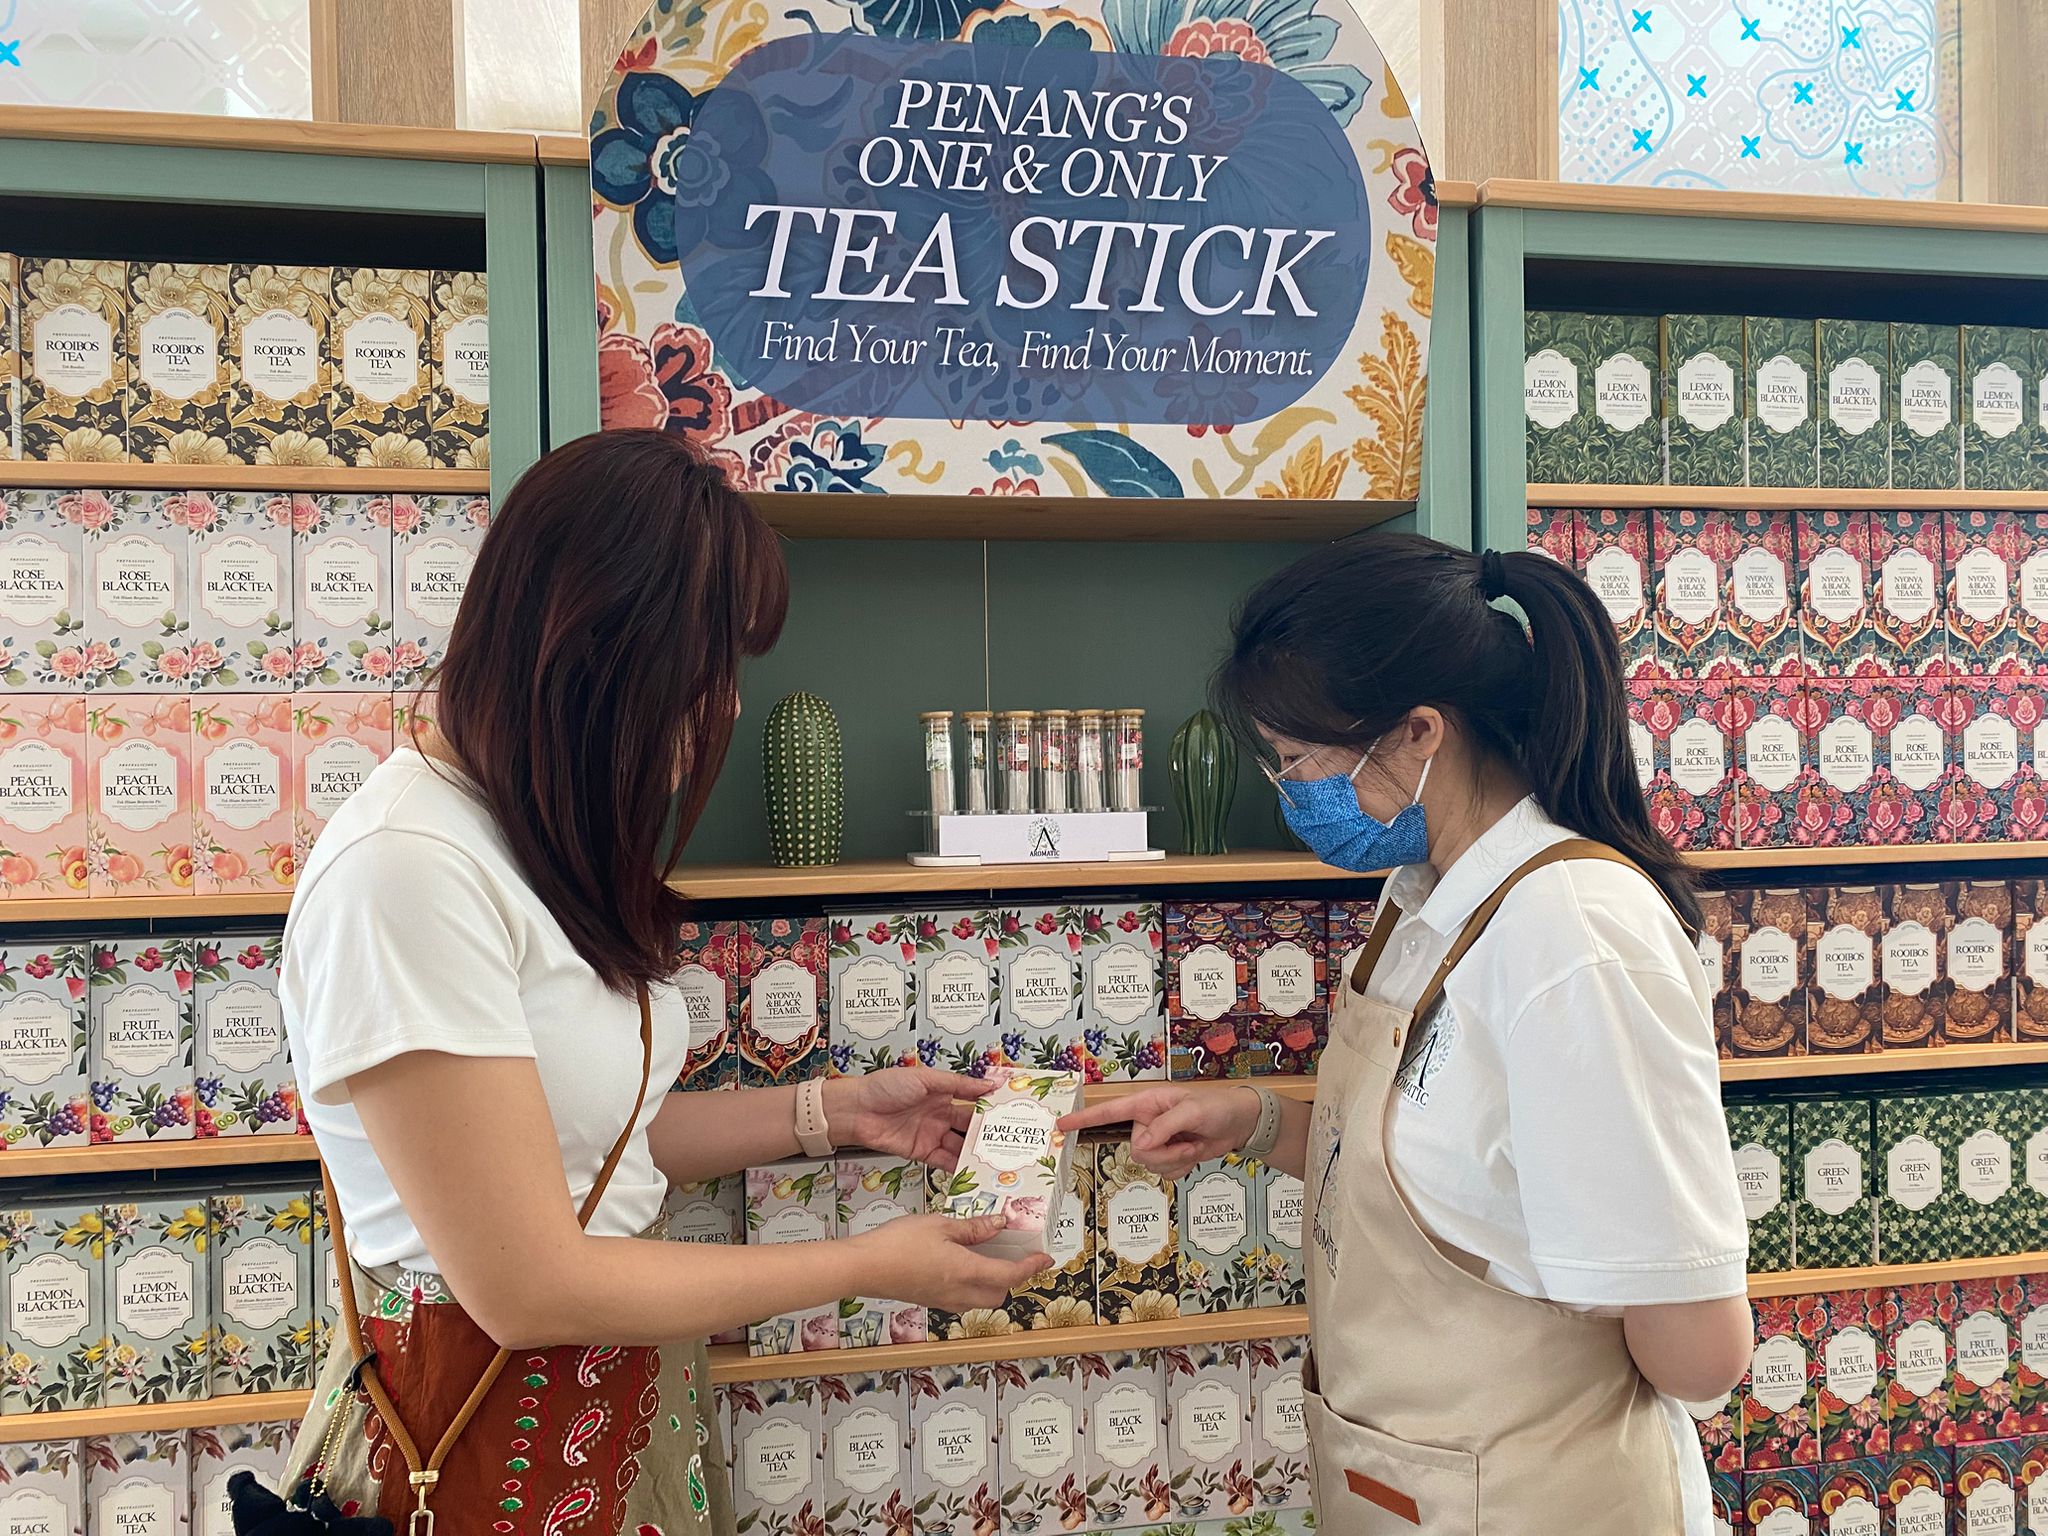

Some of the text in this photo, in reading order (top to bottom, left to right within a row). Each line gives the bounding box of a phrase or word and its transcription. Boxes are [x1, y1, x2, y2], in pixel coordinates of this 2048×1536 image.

[890, 80, 1192, 144] PENANG'S
[859, 137, 1228, 201] ONE & ONLY
[745, 205, 1335, 316] TEA STICK
[46, 340, 99, 351] ROOIBOS
[152, 344, 204, 354] ROOIBOS
[254, 345, 305, 356] ROOIBOS
[759, 319, 1312, 375] Find Your Tea, Find Your Moment.
[59, 351, 84, 362] TEA
[355, 348, 405, 358] ROOIBOS
[166, 355, 190, 364] TEA
[267, 356, 291, 366] TEA
[368, 359, 391, 368] TEA
[1533, 379, 1566, 388] LEMON
[1607, 383, 1639, 391] LEMON
[1525, 389, 1574, 398] BLACK TEA
[1599, 392, 1647, 402] BLACK TEA
[13, 569, 44, 579] ROSE
[119, 571, 151, 580] ROSE
[224, 571, 254, 580] ROSE
[326, 572, 356, 581] ROSE
[426, 572, 456, 582] ROSE
[39, 581, 64, 590] TEA
[103, 581, 170, 591] BLACK TEA
[208, 582, 273, 591] BLACK TEA
[311, 582, 373, 592] BLACK TEA
[411, 582, 448, 592] BLACK
[1686, 748, 1708, 756] ROSE
[1762, 744, 1784, 752] ROSE
[1674, 757, 1720, 766] BLACK TEA
[1750, 753, 1796, 762] BLACK TEA
[11, 776, 52, 786] PEACH
[116, 775, 156, 785] PEACH
[220, 774, 260, 784] PEACH
[321, 772, 360, 782] PEACH
[0, 787, 67, 797] BLACK TEA
[106, 786, 172, 796] BLACK TEA
[210, 784, 275, 794] BLACK TEA
[311, 783, 350, 792] BLACK
[1750, 955, 1788, 964] ROOIBOS
[1825, 952, 1864, 962] ROOIBOS
[1760, 965, 1778, 974] TEA
[1836, 963, 1854, 971] TEA
[1194, 971, 1224, 981] BLACK
[1271, 969, 1302, 977] BLACK
[1026, 977, 1056, 987] FRUIT
[1108, 974, 1138, 984] FRUIT
[1276, 978, 1295, 986] TEA
[943, 983, 973, 992] FRUIT
[1098, 984, 1149, 994] BLACK TEA
[1199, 982, 1217, 990] TEA
[766, 991, 802, 1001] NYONYA
[857, 988, 888, 998] FRUIT
[931, 992, 985, 1002] BLACK TEA
[1015, 987, 1068, 997] BLACK TEA
[774, 999, 800, 1009] BLACK
[845, 997, 900, 1008] BLACK TEA
[123, 1020, 159, 1030] FRUIT
[226, 1017, 262, 1027] FRUIT
[14, 1028, 51, 1038] FRUIT
[109, 1030, 174, 1041] BLACK TEA
[213, 1027, 276, 1038] BLACK TEA
[0, 1038, 67, 1050] BLACK TEA
[1393, 1071, 1429, 1106] ROMATIC
[983, 1125, 1048, 1137] EARL GREY
[982, 1133, 1045, 1144] BLACK TEA
[1817, 1167, 1849, 1176] GREEN
[1900, 1163, 1930, 1172] GREEN
[1824, 1177, 1843, 1185] TEA
[1906, 1173, 1924, 1181] TEA
[1200, 1203, 1234, 1214] LEMON
[1118, 1212, 1159, 1224] ROOIBOS
[1193, 1212, 1244, 1225] BLACK TEA
[1128, 1224, 1148, 1233] TEA
[698, 1232, 729, 1243] GREY
[238, 1272, 281, 1284] LEMON
[133, 1281, 177, 1293] LEMON
[229, 1282, 293, 1295] BLACK TEA
[27, 1289, 72, 1302] LEMON
[123, 1291, 188, 1304] BLACK TEA
[17, 1299, 84, 1312] BLACK TEA
[1970, 1339, 1994, 1349] FRUIT
[1960, 1347, 2004, 1358] BLACK TEA
[1766, 1364, 1790, 1374] FRUIT
[1755, 1372, 1802, 1384] BLACK TEA
[1109, 1415, 1142, 1428] BLACK
[1193, 1411, 1226, 1422] BLACK
[1025, 1424, 1058, 1438] BLACK
[1115, 1426, 1134, 1436] TEA
[1199, 1422, 1219, 1431] TEA
[938, 1434, 971, 1446] BLACK
[1031, 1436, 1051, 1446] TEA
[849, 1439, 884, 1452] BLACK
[944, 1445, 964, 1455] TEA
[760, 1450, 795, 1464] BLACK
[855, 1451, 876, 1461] TEA
[766, 1461, 787, 1472] TEA
[116, 1512, 156, 1524] BLACK
[10, 1523, 50, 1534] BLACK
[123, 1524, 146, 1534] TEA
